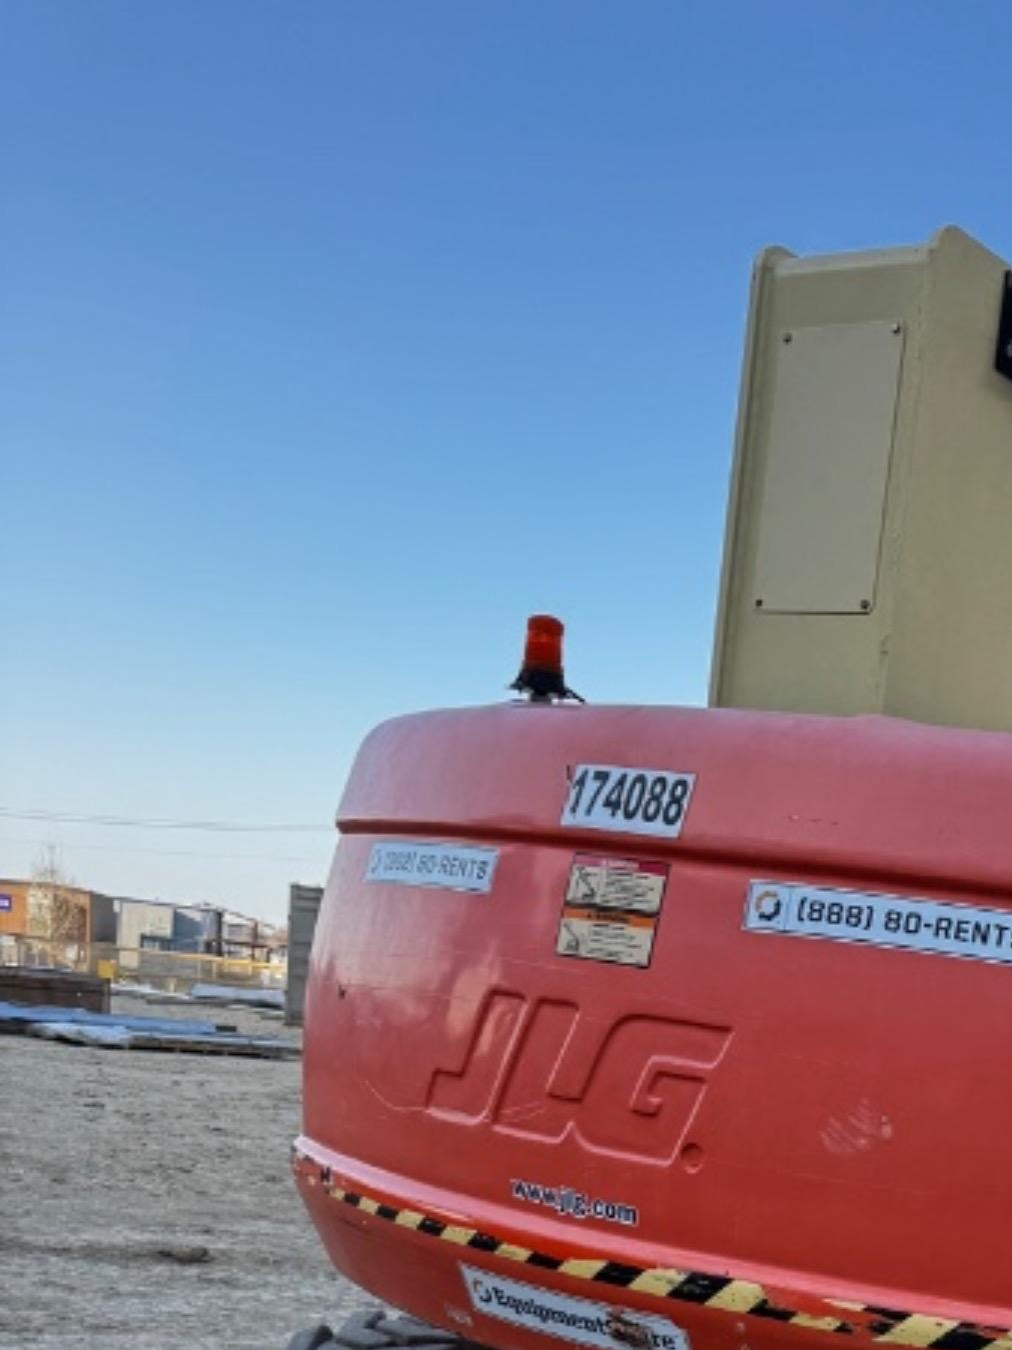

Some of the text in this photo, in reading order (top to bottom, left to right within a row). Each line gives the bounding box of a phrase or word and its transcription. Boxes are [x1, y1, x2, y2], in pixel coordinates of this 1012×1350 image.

[570, 768, 689, 826] 174088
[796, 896, 874, 931] (888)
[426, 988, 735, 1167] JLG
[511, 1179, 639, 1227] www.jlg.com
